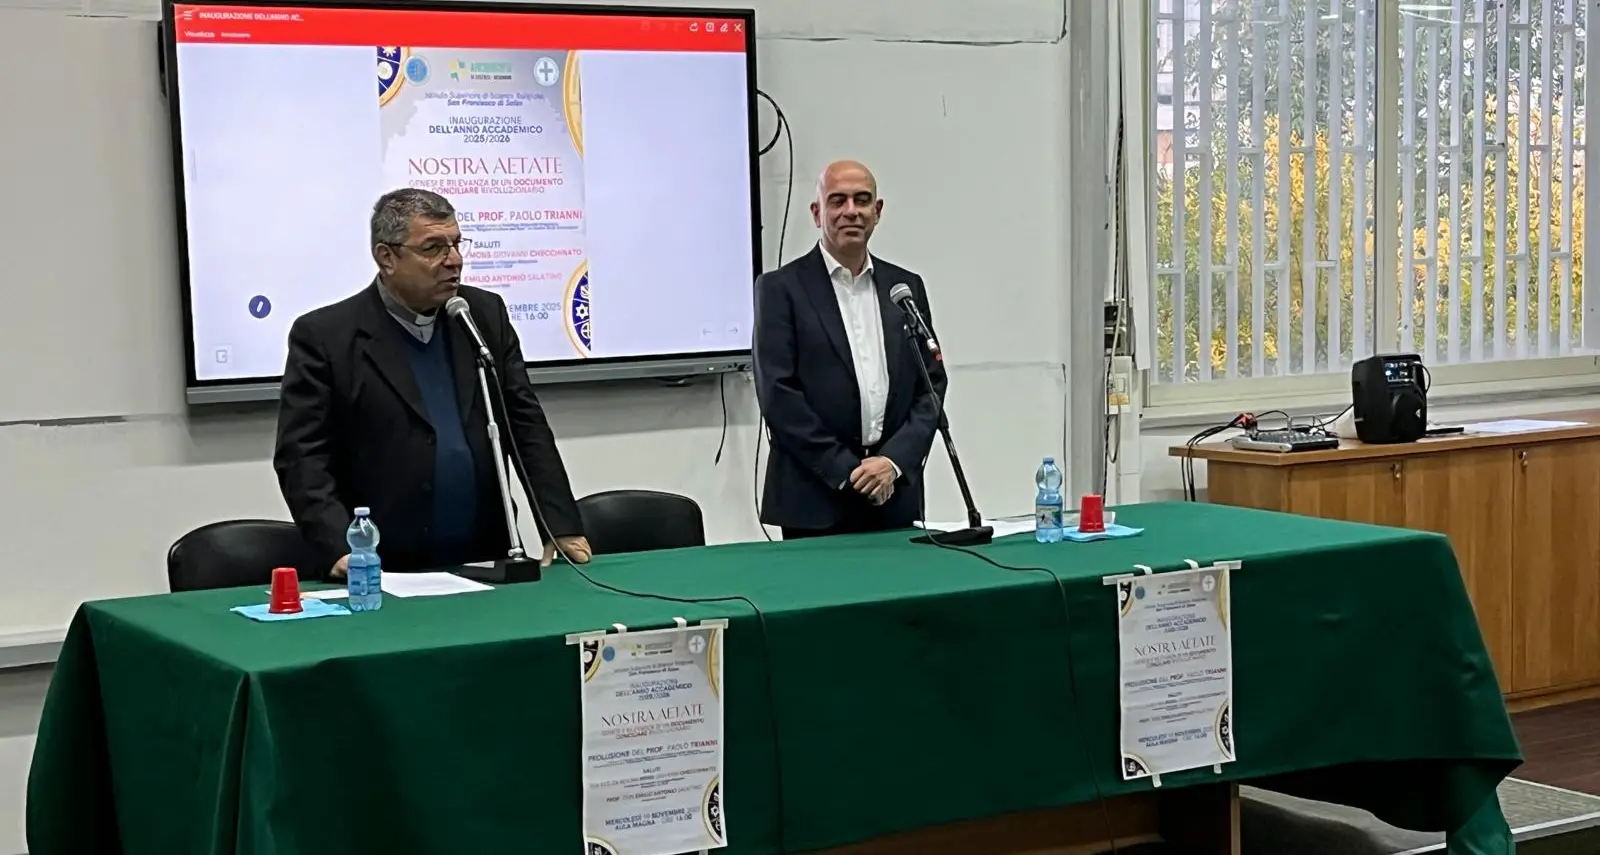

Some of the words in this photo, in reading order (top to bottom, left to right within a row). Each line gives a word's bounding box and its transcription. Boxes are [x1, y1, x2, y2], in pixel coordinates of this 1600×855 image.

[449, 116, 522, 125] INAUGURAZIONE
[429, 125, 479, 134] DELL'ANNO
[482, 125, 543, 134] ACCADEMICO
[463, 134, 511, 143] 2025/2026
[408, 157, 489, 175] NOSTRA
[493, 156, 562, 174] AETATE
[513, 178, 563, 186] DOCUMENTO
[431, 186, 479, 195] CONCILIARE
[457, 212, 475, 222] DEL
[478, 211, 508, 222] PROF.
[510, 210, 542, 221] PAOLO
[543, 210, 583, 220] TRIANNI
[474, 240, 501, 249] SALUTI
[464, 275, 491, 283] EMILIO
[492, 274, 527, 282] ANTONIO
[541, 302, 562, 311] 2025
[1134, 642, 1177, 657] NOSTRA
[651, 683, 693, 694] ACCADEMICO
[601, 709, 655, 728] NOSTRA
[656, 703, 705, 722] AETATE
[588, 751, 630, 762] PROLUSIONE
[690, 740, 718, 749] TRIANNI
[632, 820, 656, 829] MAGNA
